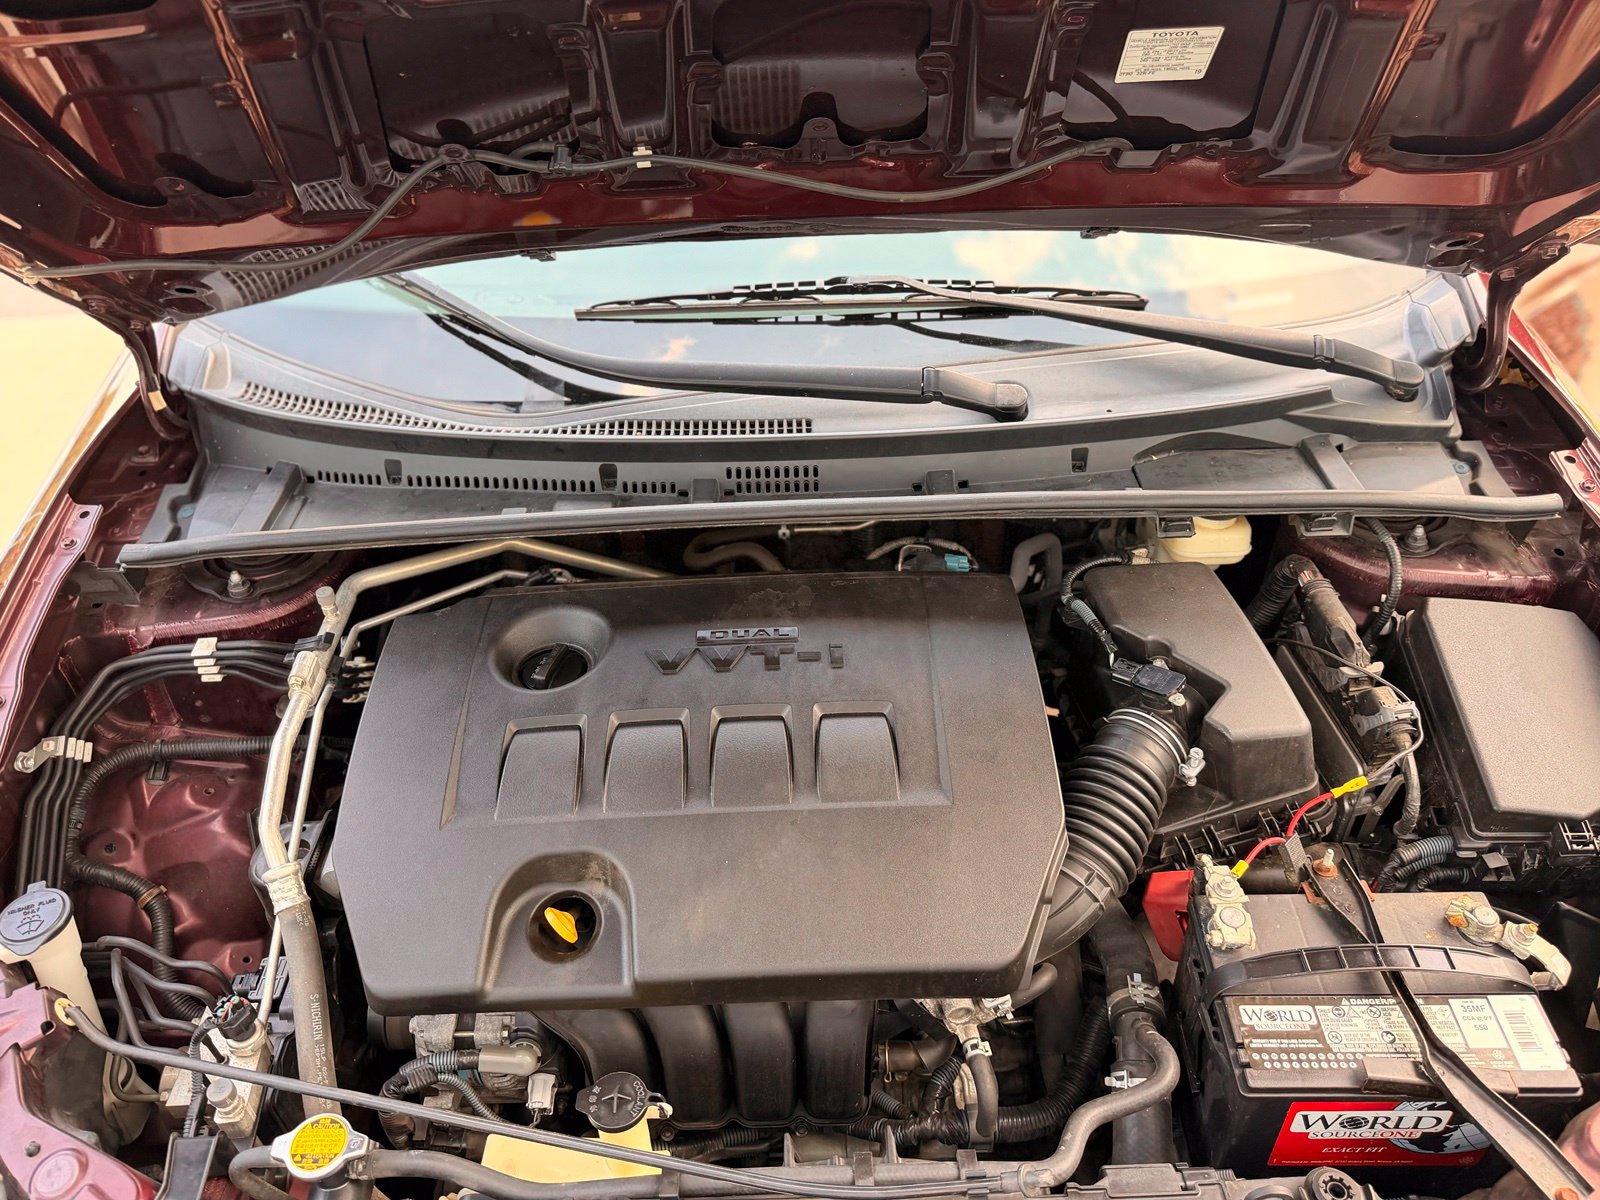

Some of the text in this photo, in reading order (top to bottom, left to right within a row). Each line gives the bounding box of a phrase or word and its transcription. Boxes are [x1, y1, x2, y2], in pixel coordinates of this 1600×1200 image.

[710, 628, 790, 639] DUAL
[644, 643, 844, 675] VVT-i
[1242, 1008, 1312, 1022] WORLD
[630, 1080, 646, 1118] COOLANT
[1299, 1114, 1443, 1130] WORLD
